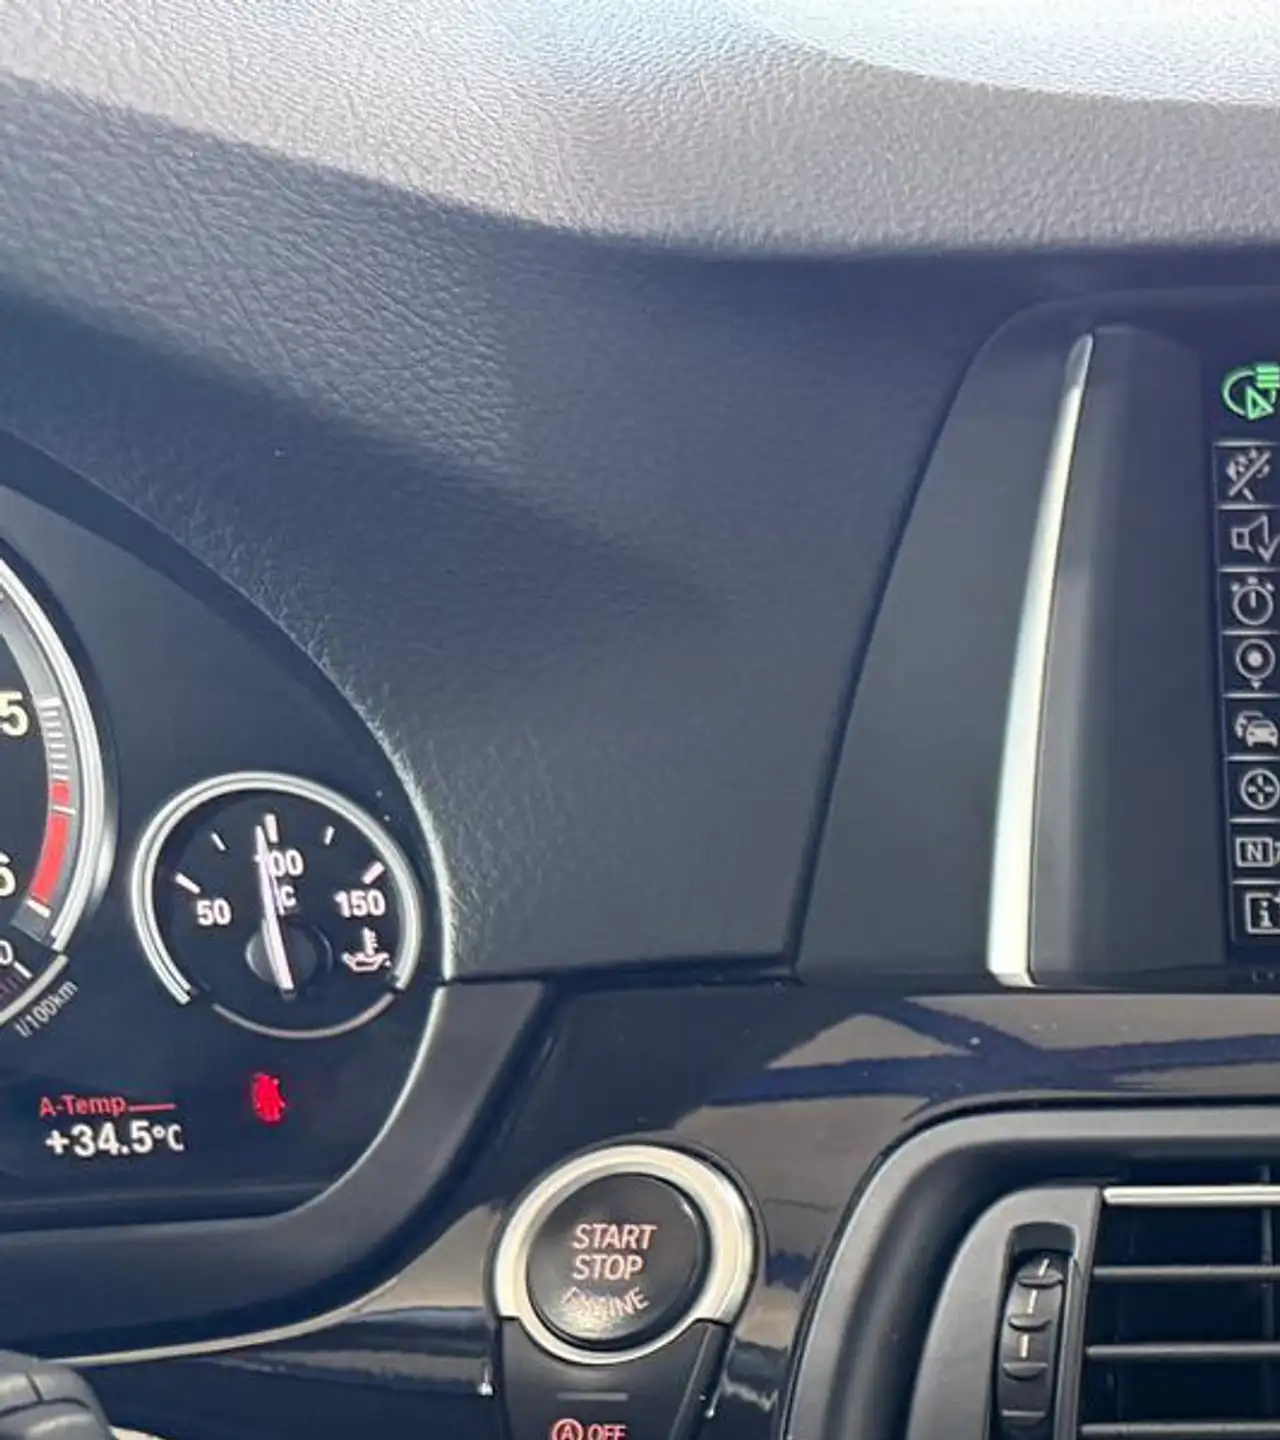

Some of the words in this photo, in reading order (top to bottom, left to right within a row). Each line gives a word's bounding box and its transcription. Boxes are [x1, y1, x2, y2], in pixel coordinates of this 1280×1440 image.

[197, 898, 232, 926] 50
[334, 888, 386, 917] 150
[39, 1094, 127, 1118] A-Temp
[572, 1223, 657, 1251] START
[572, 1254, 644, 1282] STOP
